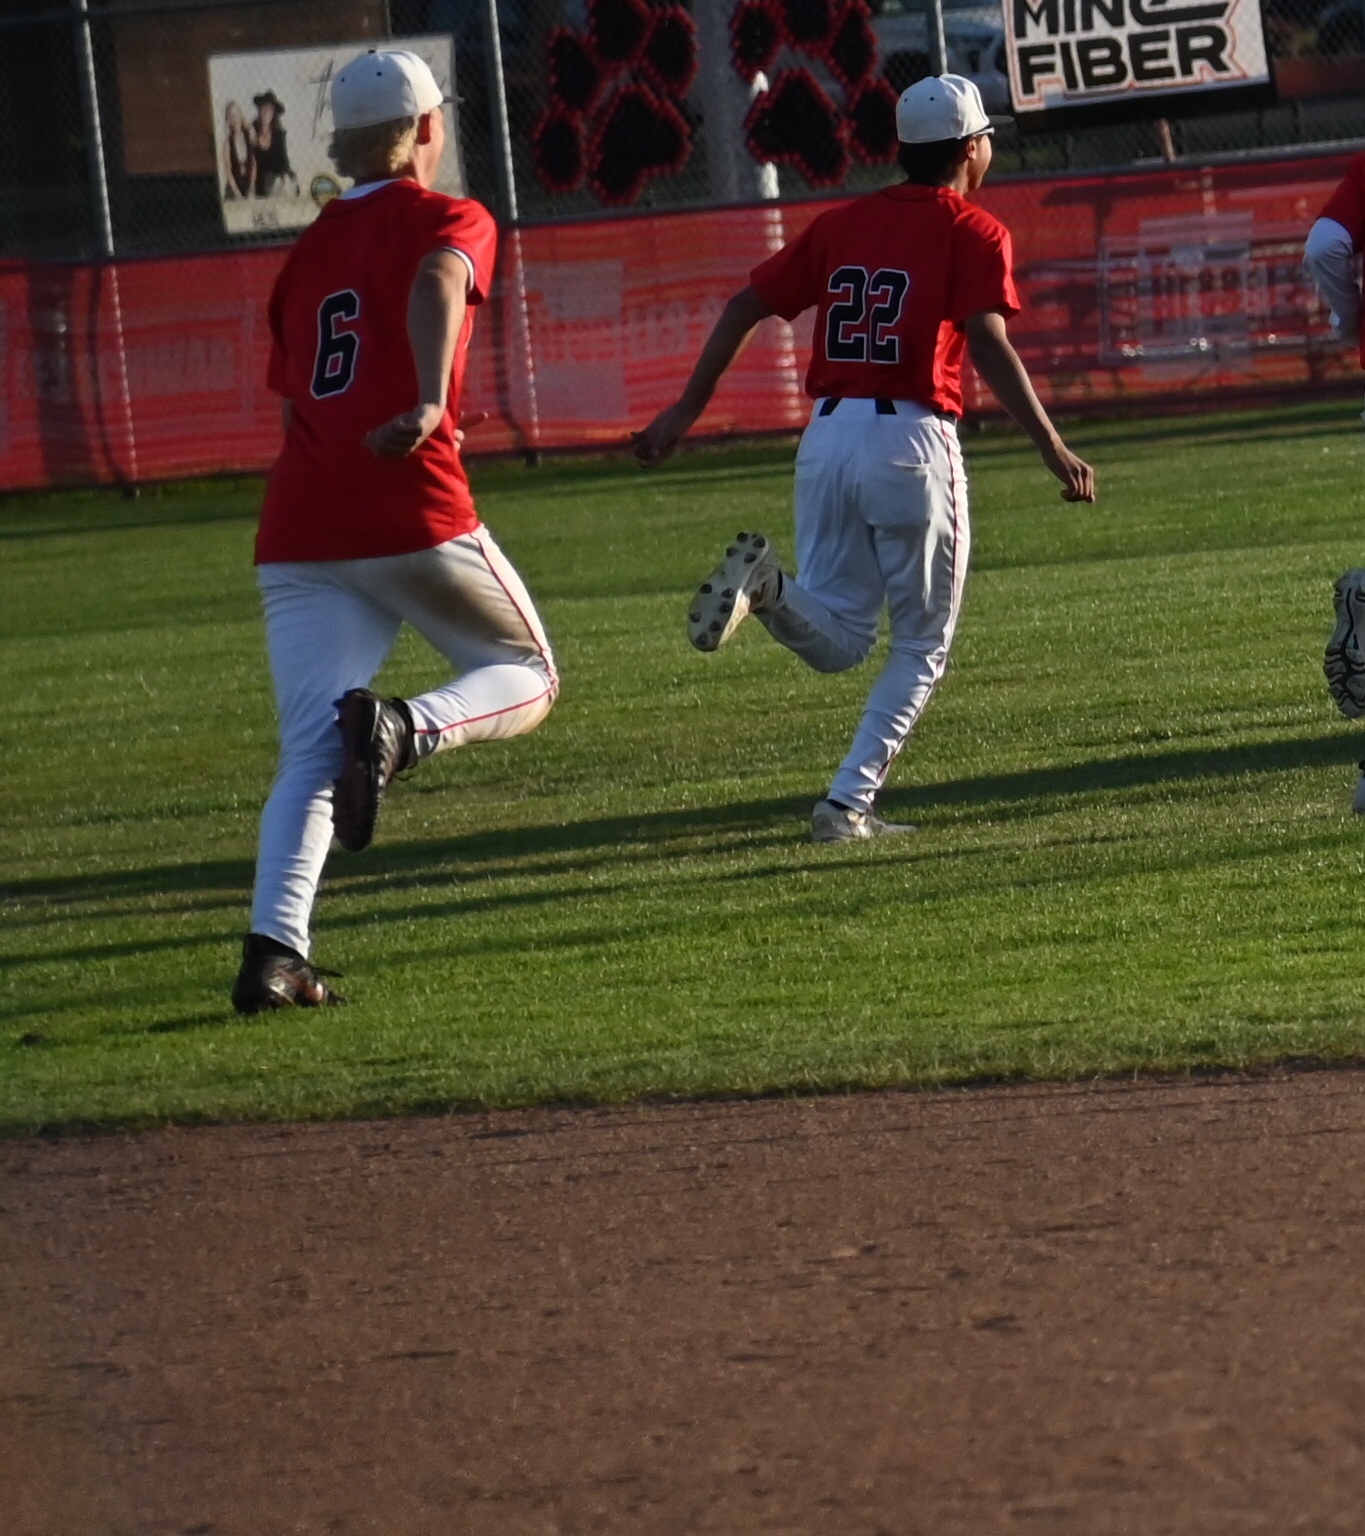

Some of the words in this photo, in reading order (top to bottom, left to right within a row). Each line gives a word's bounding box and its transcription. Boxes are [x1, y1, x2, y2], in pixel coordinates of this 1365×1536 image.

[1018, 25, 1231, 97] FIBER
[310, 289, 361, 400] 6
[826, 266, 910, 364] 22
